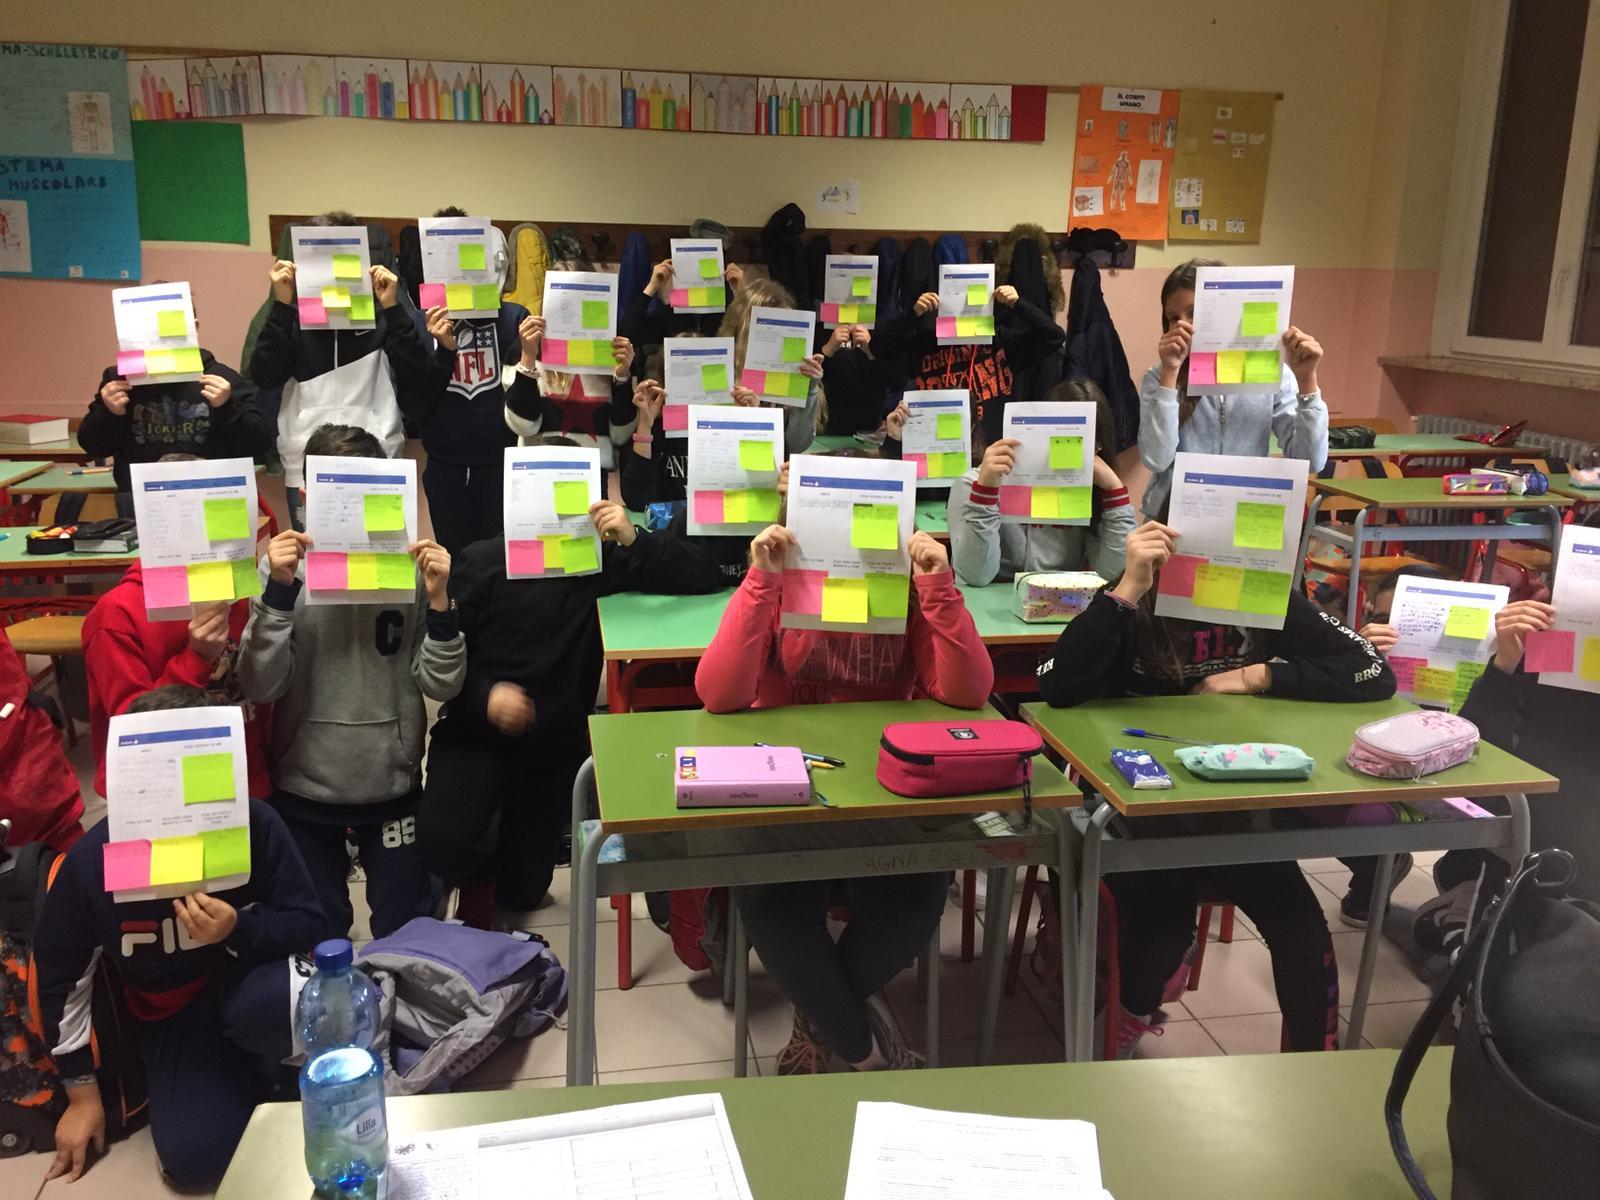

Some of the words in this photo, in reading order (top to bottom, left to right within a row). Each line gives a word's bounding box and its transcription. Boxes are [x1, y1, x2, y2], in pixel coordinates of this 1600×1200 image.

[0, 44, 119, 60] MA-SCHELETRICO
[8, 175, 107, 192] MUSCOLARE
[450, 351, 493, 385] NFL
[666, 455, 688, 478] AN
[376, 610, 404, 656] C
[825, 635, 899, 685] WHA
[382, 814, 416, 848] 85
[120, 916, 213, 957] FIL
[356, 1118, 377, 1135] Lilla
